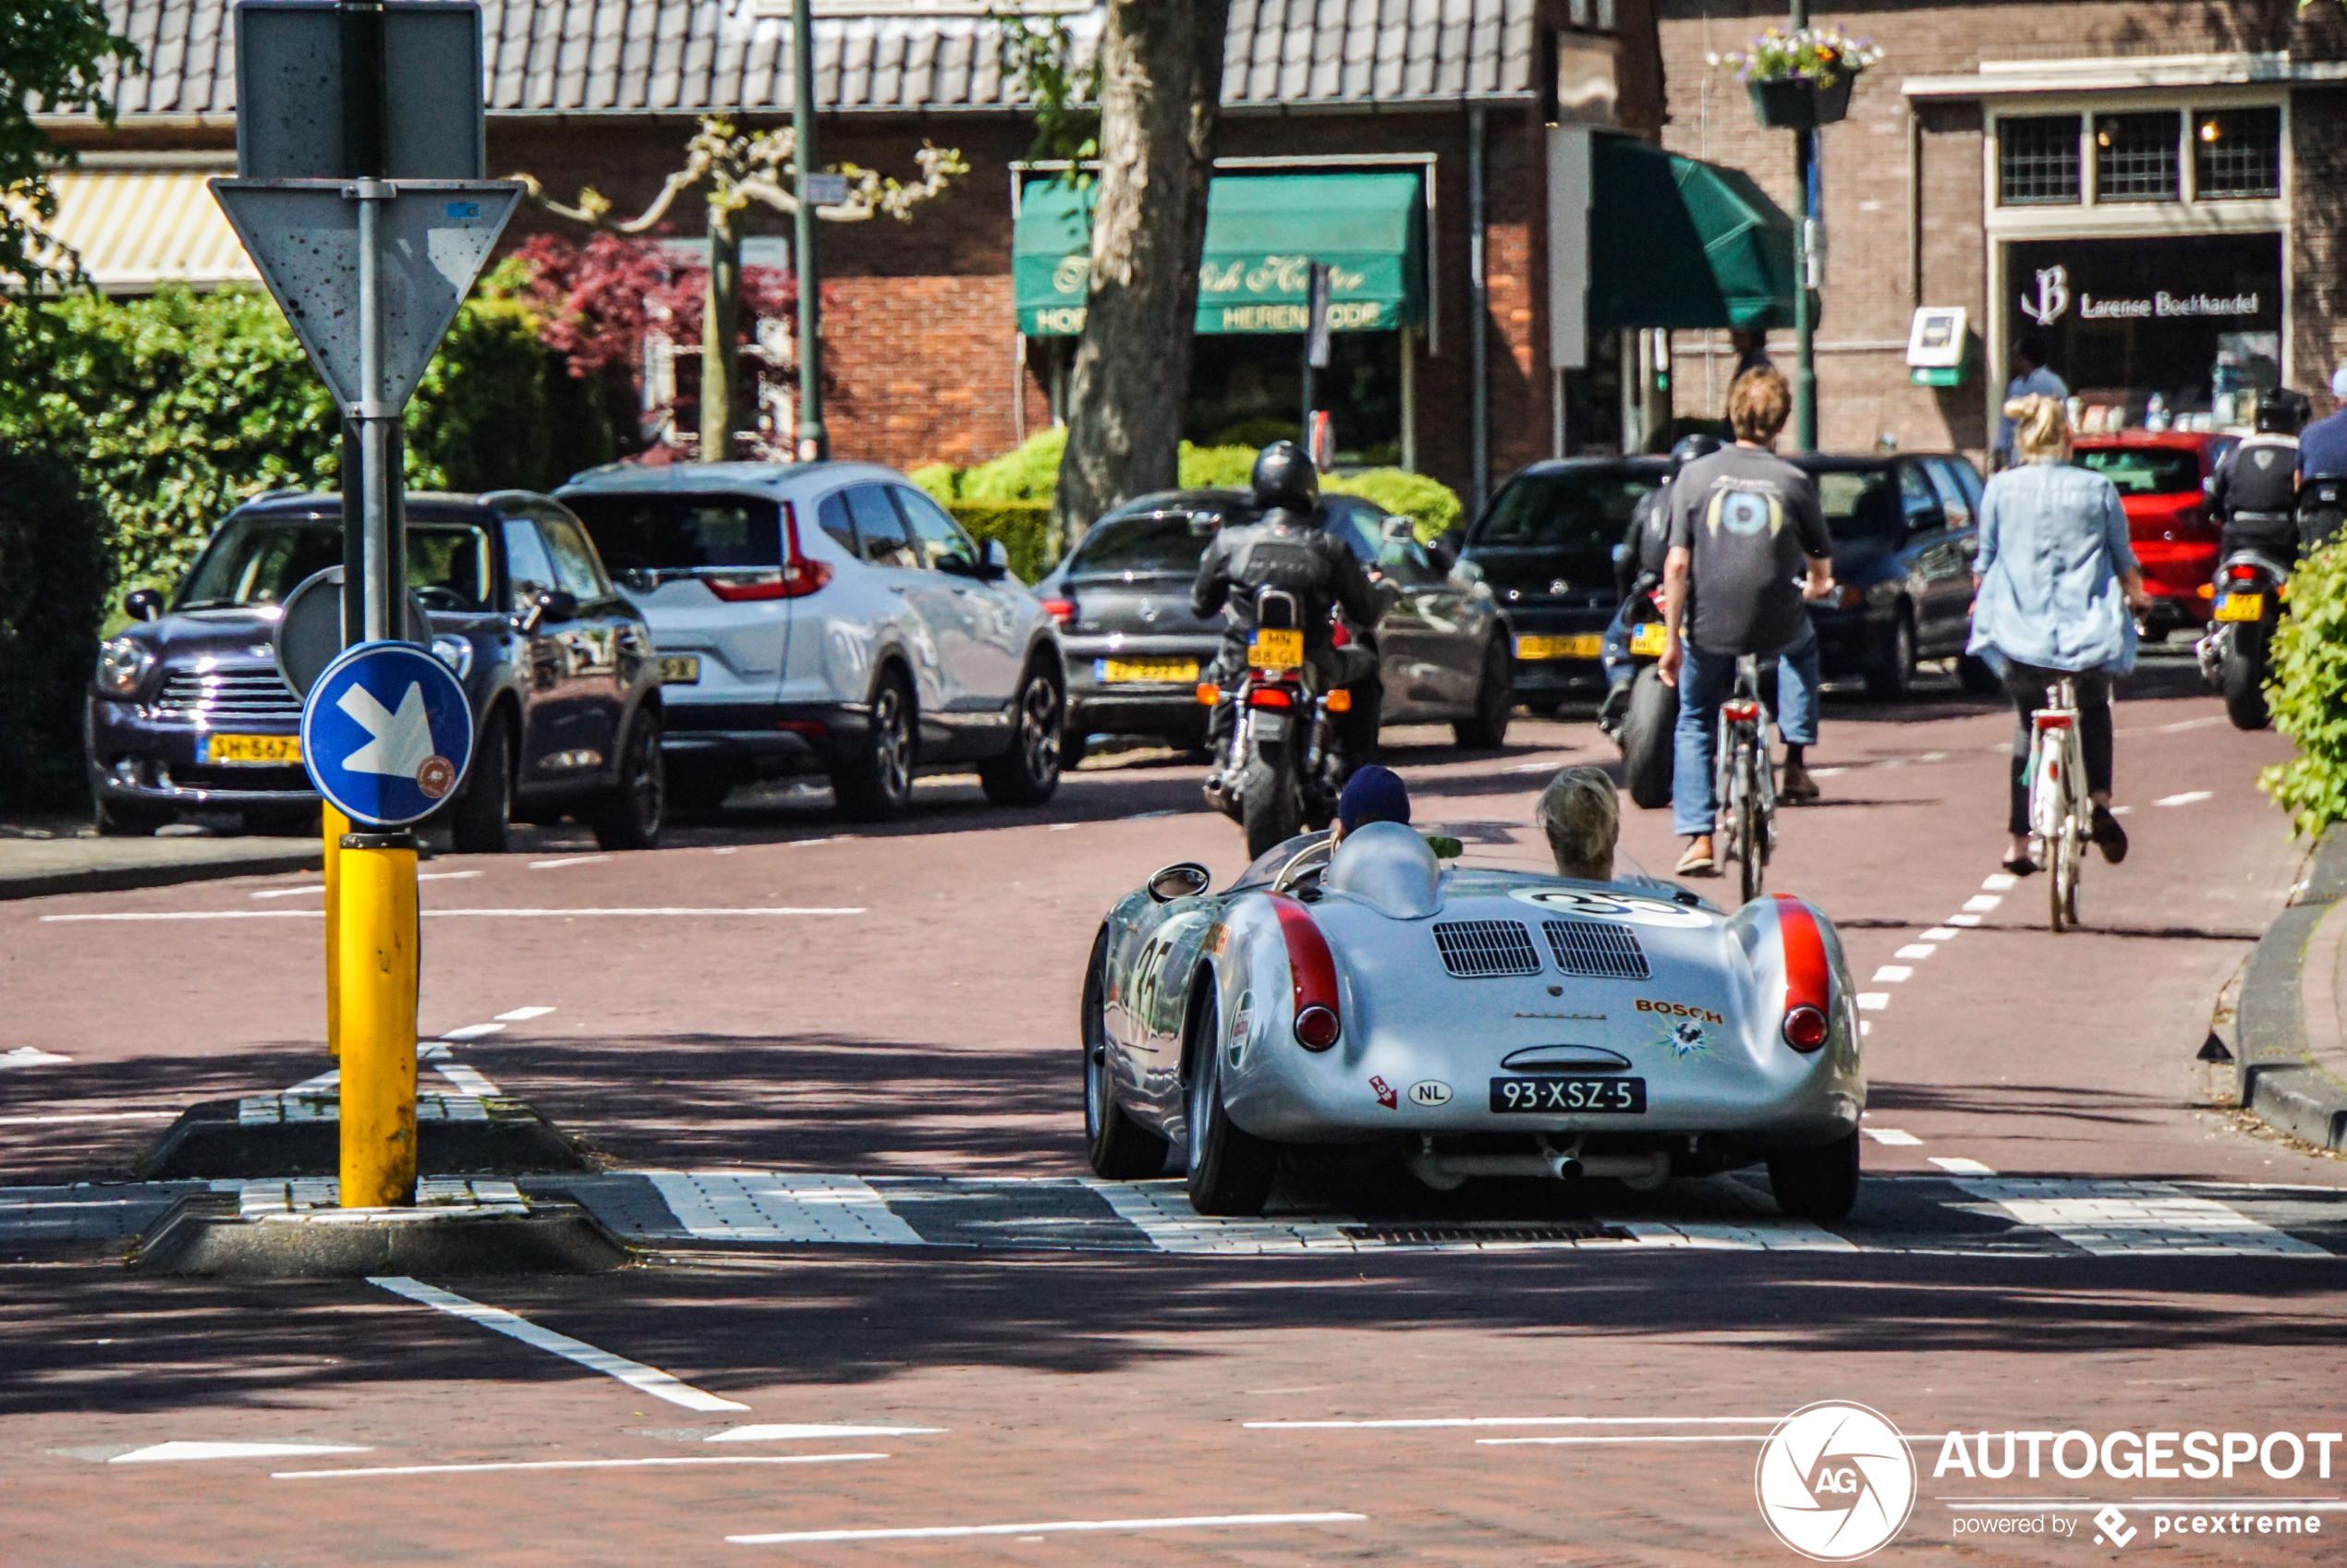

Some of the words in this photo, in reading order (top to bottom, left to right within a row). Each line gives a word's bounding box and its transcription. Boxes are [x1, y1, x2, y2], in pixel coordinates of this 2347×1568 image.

[2155, 290, 2259, 316] Boekhandel
[1222, 304, 1381, 331] HERENODE
[1531, 893, 1690, 915] 35
[1636, 999, 1723, 1025] BOSCH
[1371, 1077, 1392, 1100] TOW
[1419, 1085, 1445, 1100] NL
[1502, 1082, 1632, 1108] 93-XSZ-5
